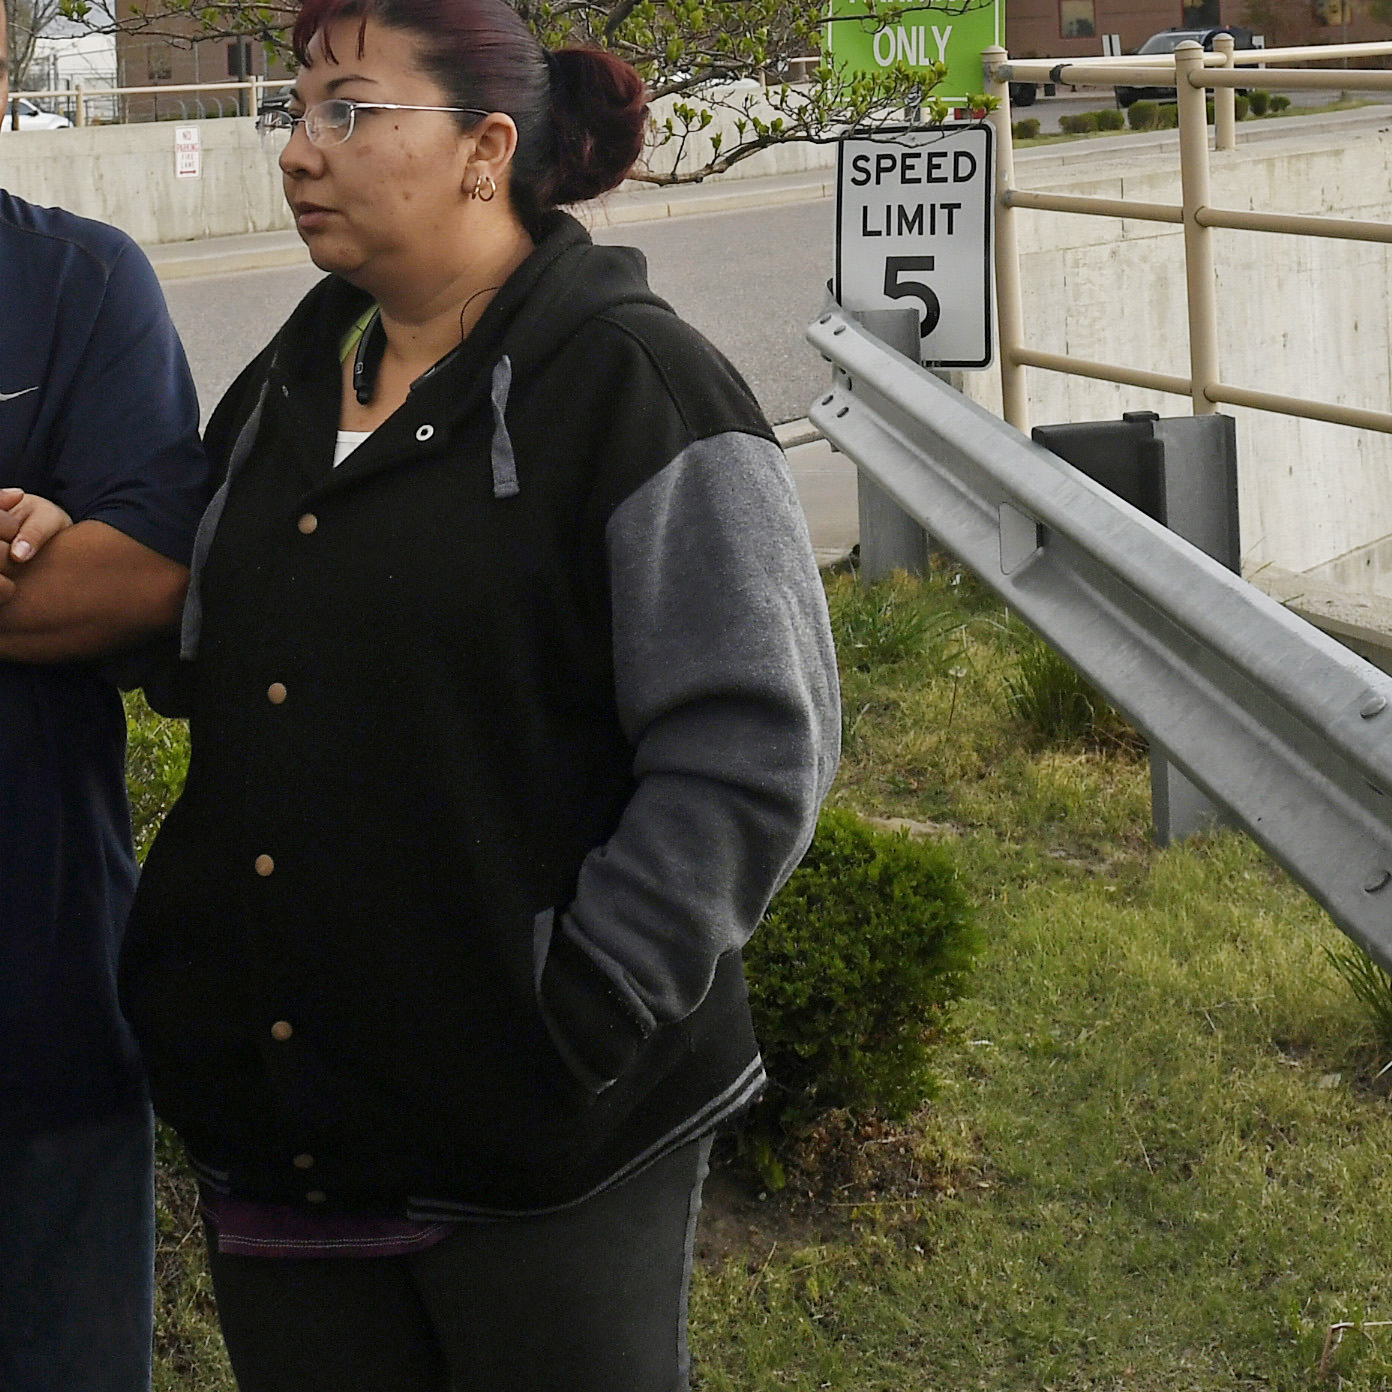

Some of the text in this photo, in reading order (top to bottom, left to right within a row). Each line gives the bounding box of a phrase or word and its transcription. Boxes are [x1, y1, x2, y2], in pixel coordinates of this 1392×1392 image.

[873, 25, 952, 67] ONLY
[851, 151, 977, 186] SPEED
[862, 203, 962, 237] LIMIT
[883, 256, 940, 339] 5
